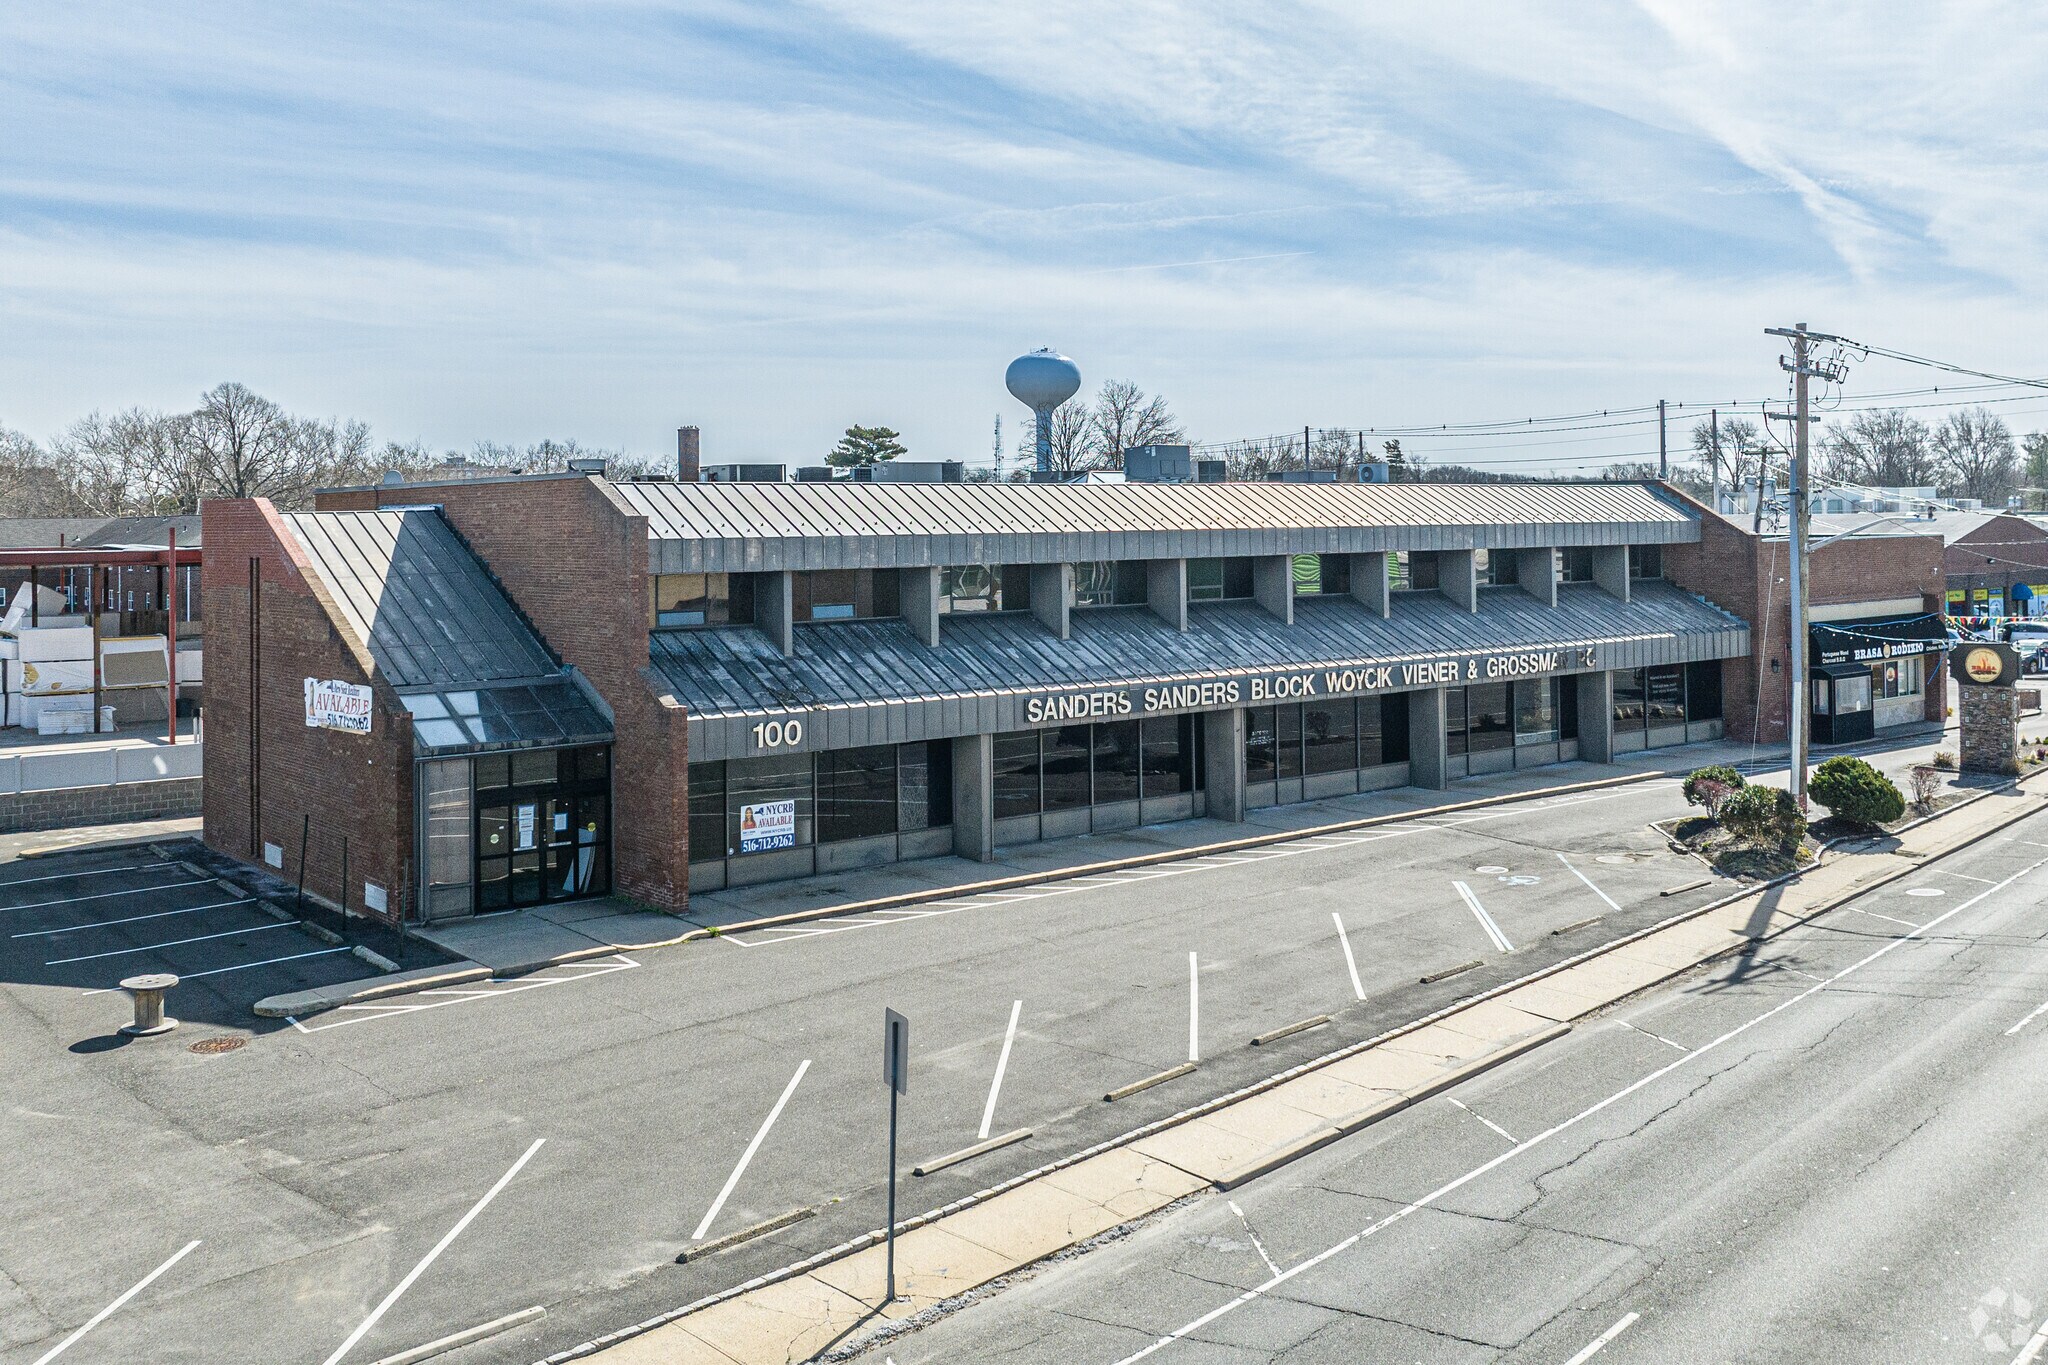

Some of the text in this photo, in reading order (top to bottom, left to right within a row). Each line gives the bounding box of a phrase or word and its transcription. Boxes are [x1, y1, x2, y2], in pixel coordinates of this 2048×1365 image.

[1854, 648, 1882, 660] BRASA
[1891, 642, 1924, 656] RODIZIO
[1027, 690, 1132, 723] SANDERS
[1144, 680, 1240, 712] SANDERS
[1251, 673, 1316, 700] BLOCK
[1325, 666, 1393, 693] WOYCIK
[1402, 661, 1459, 685] VIENER
[1467, 659, 1478, 680] &
[753, 720, 802, 748] 100
[766, 803, 794, 815] NYCRB
[758, 815, 793, 828] AVAILABLE
[742, 834, 793, 852] 516-712-9262
